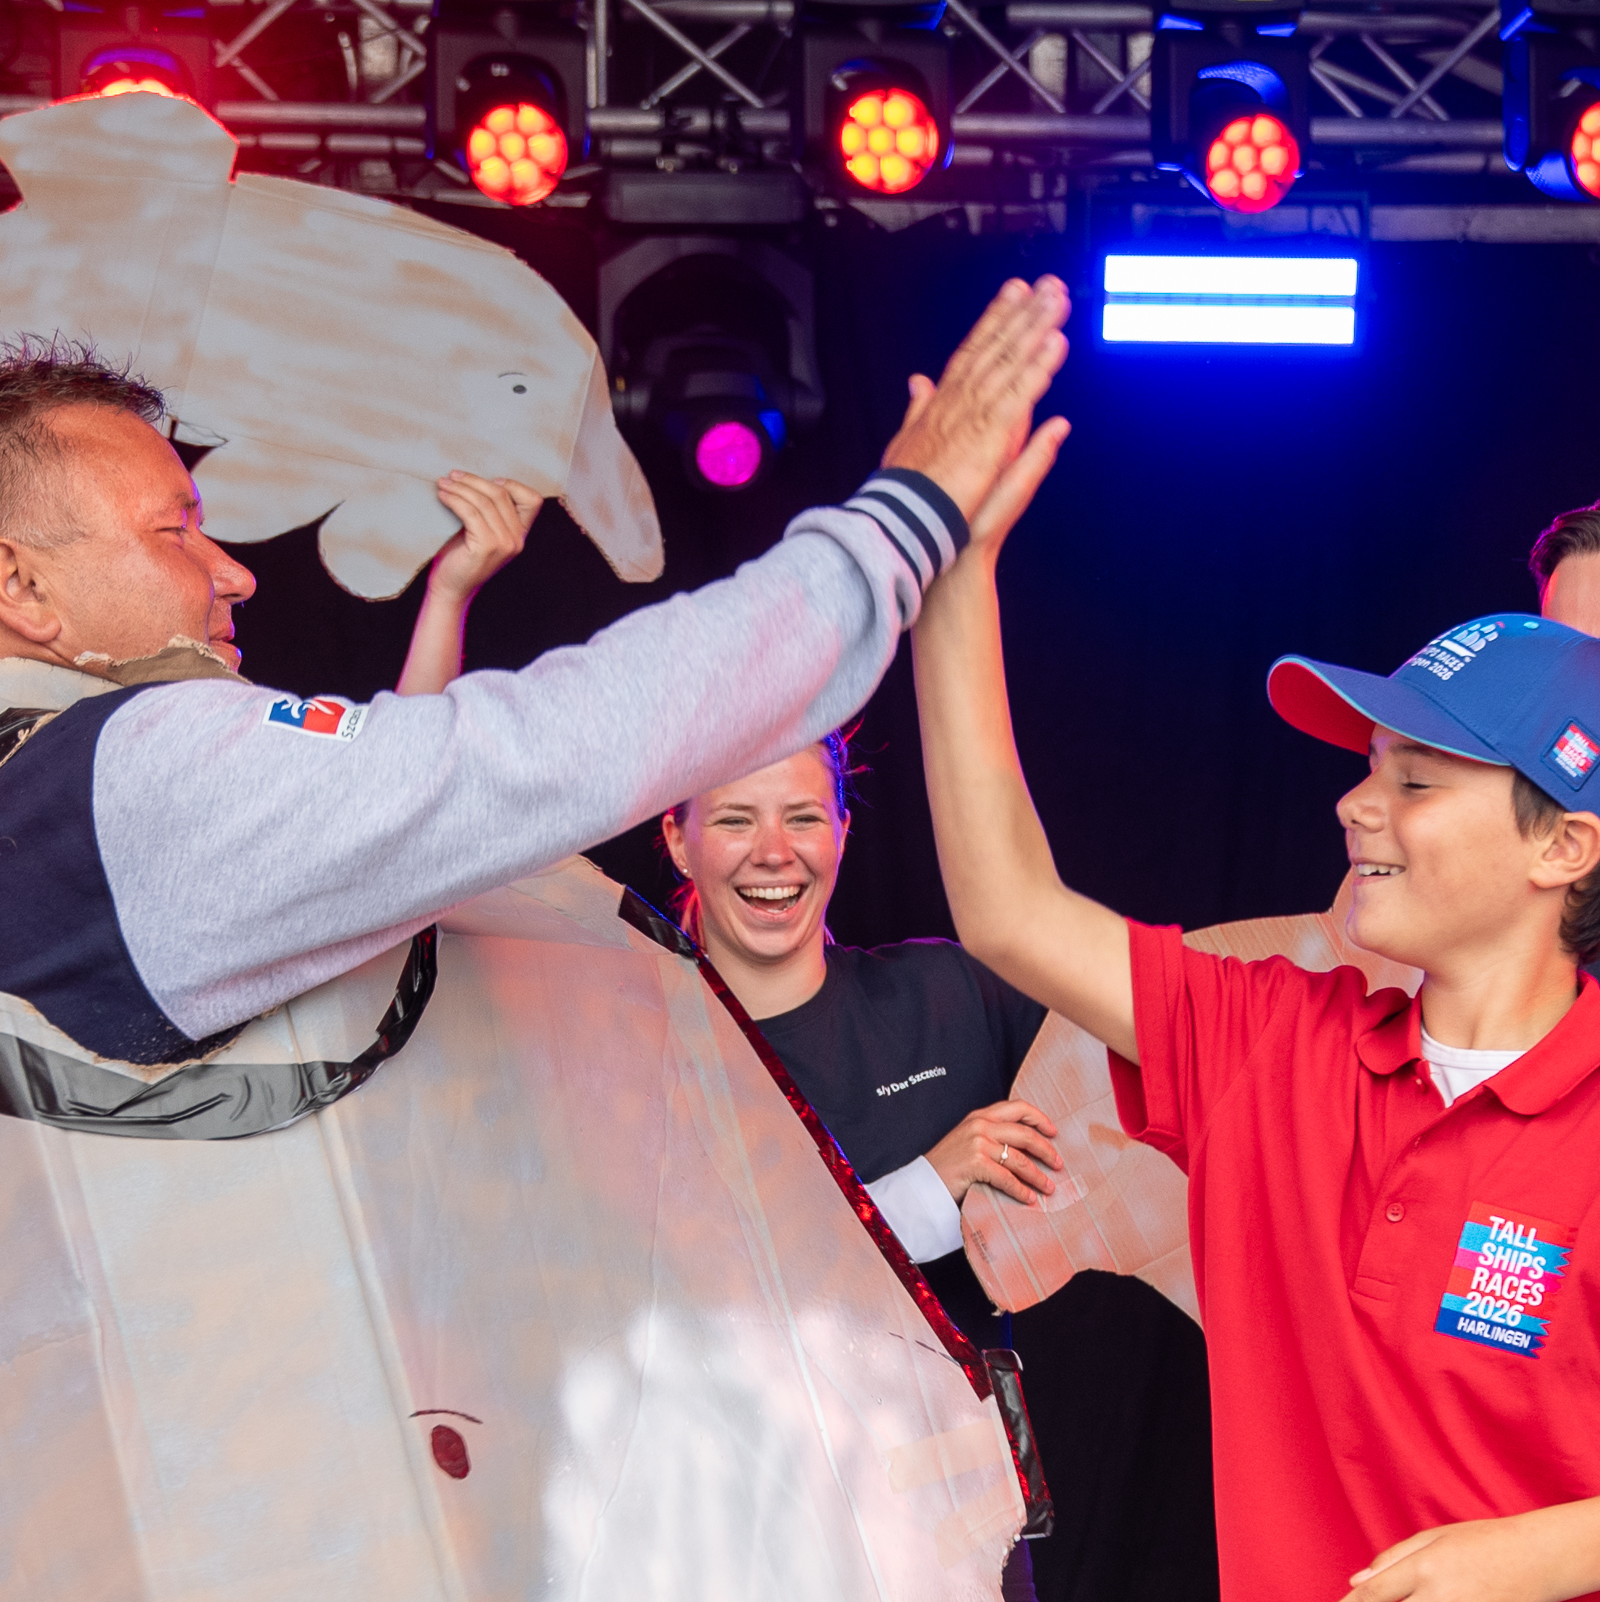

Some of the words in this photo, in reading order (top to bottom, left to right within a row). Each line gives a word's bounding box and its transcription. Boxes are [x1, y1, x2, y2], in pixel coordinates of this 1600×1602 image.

[1428, 662, 1454, 681] 2026
[1435, 651, 1466, 671] RACES
[876, 1084, 891, 1097] s/y
[890, 1080, 909, 1093] Dar
[1489, 1215, 1538, 1252] TALL
[1478, 1242, 1547, 1280] SHIPS
[1470, 1266, 1546, 1307] RACES
[1462, 1291, 1525, 1327] 2026
[1456, 1316, 1532, 1349] HARLINGEN
